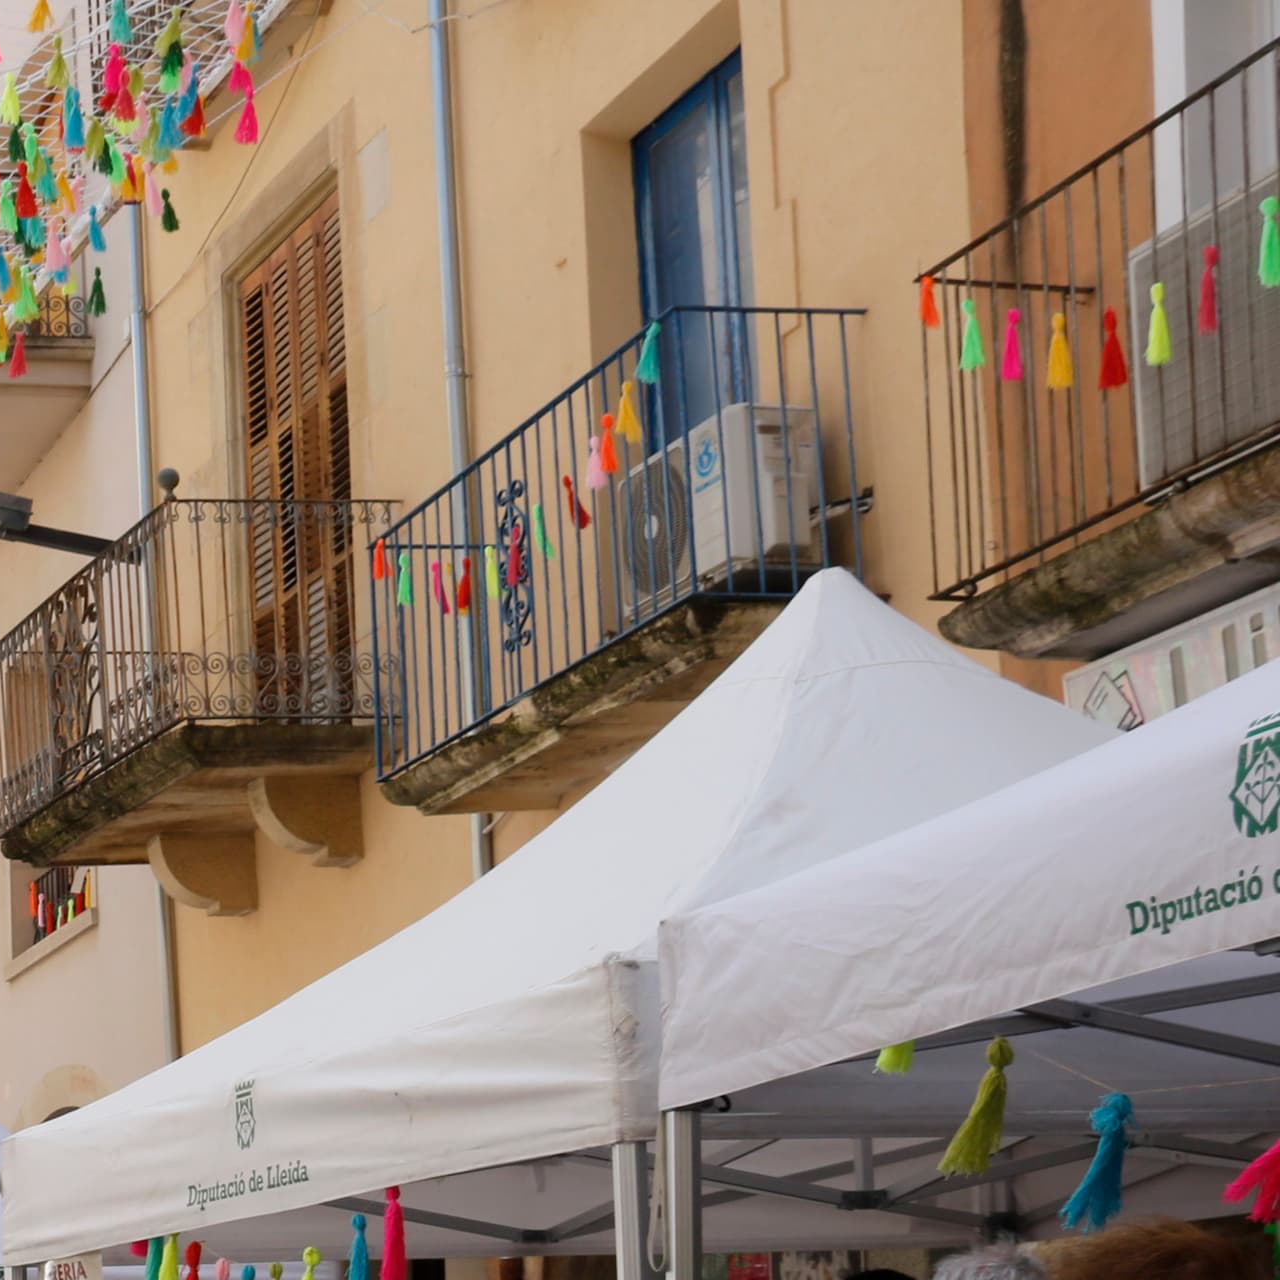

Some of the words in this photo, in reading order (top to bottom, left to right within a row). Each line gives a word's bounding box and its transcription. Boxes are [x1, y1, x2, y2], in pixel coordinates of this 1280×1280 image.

[1125, 865, 1263, 935] Diputació
[186, 1171, 246, 1211] Diputació
[248, 1169, 264, 1193] de
[266, 1159, 310, 1189] Lleida
